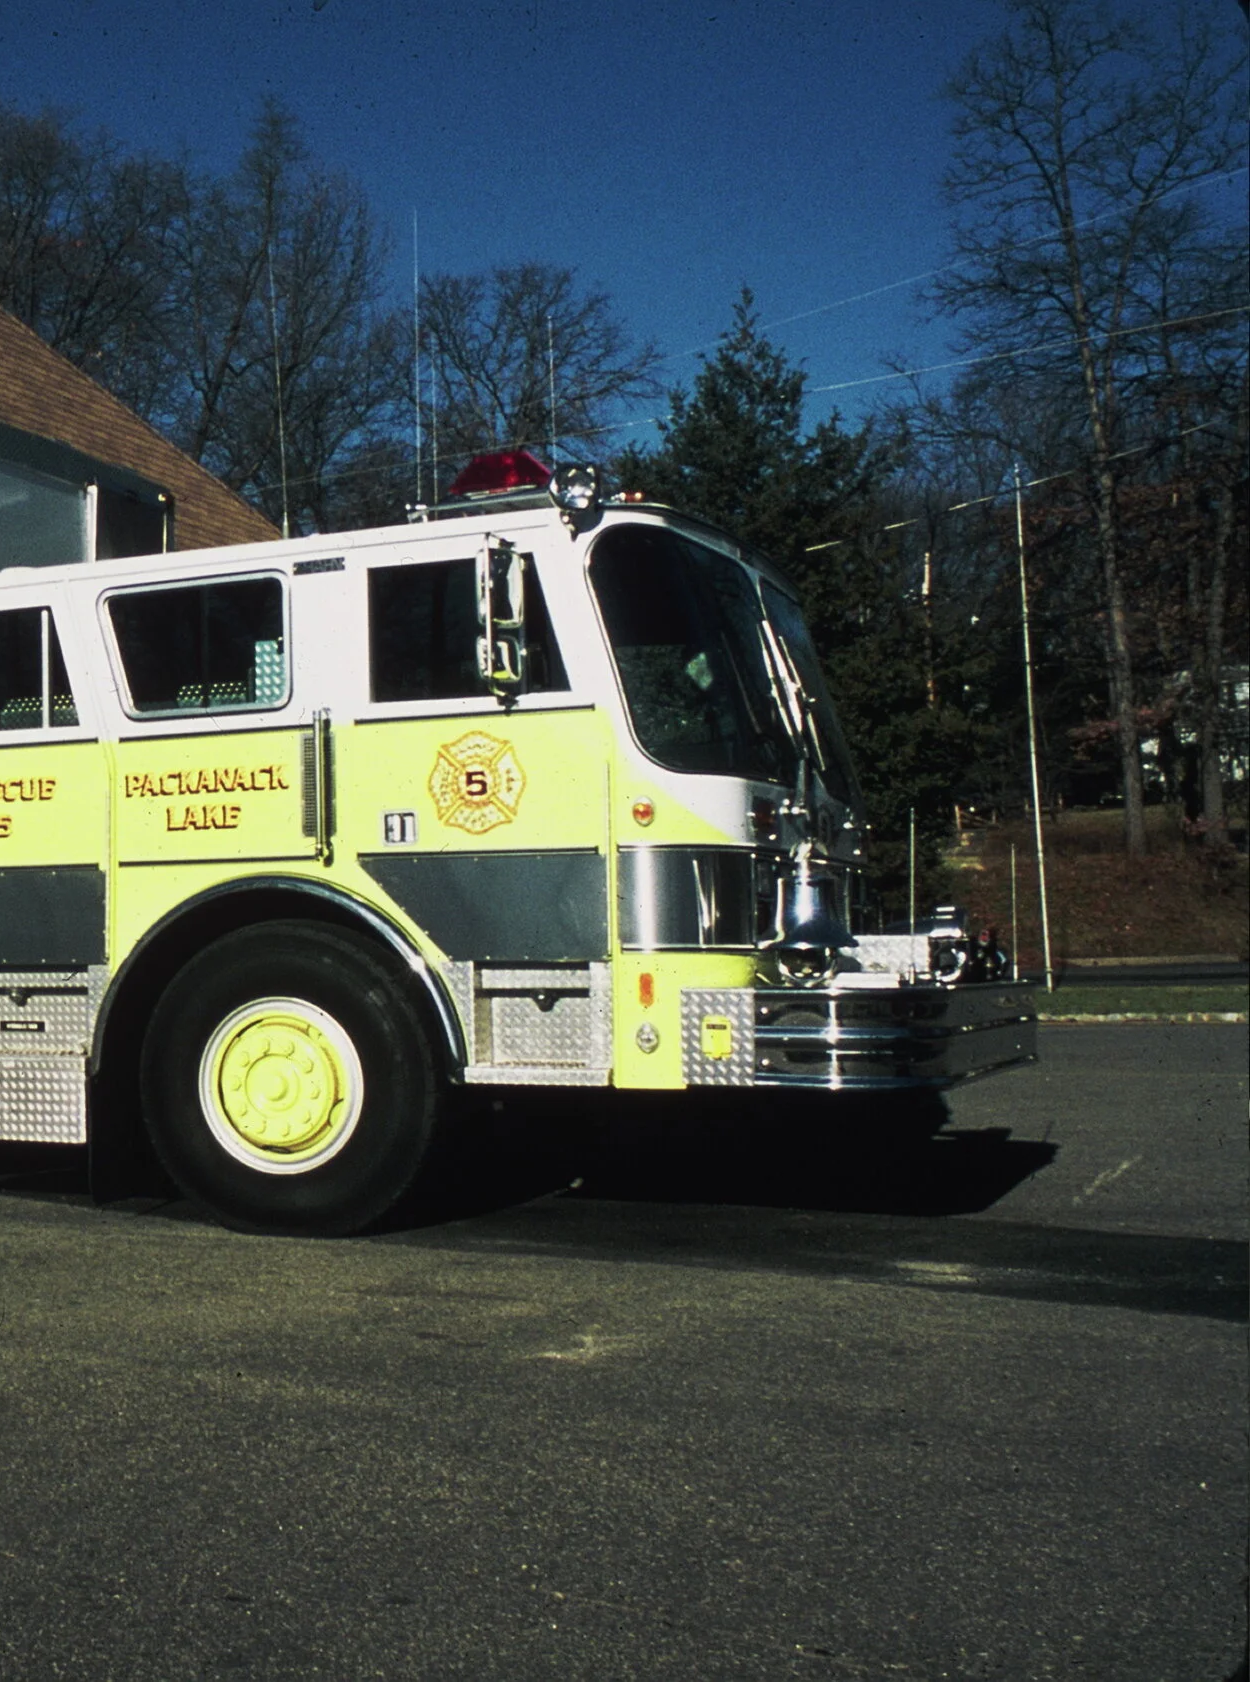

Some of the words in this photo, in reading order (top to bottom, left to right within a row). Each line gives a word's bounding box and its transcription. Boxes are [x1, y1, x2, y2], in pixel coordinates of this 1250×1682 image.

[125, 764, 290, 798] PACKANACK
[465, 770, 488, 797] 5
[166, 803, 241, 831] LAKE
